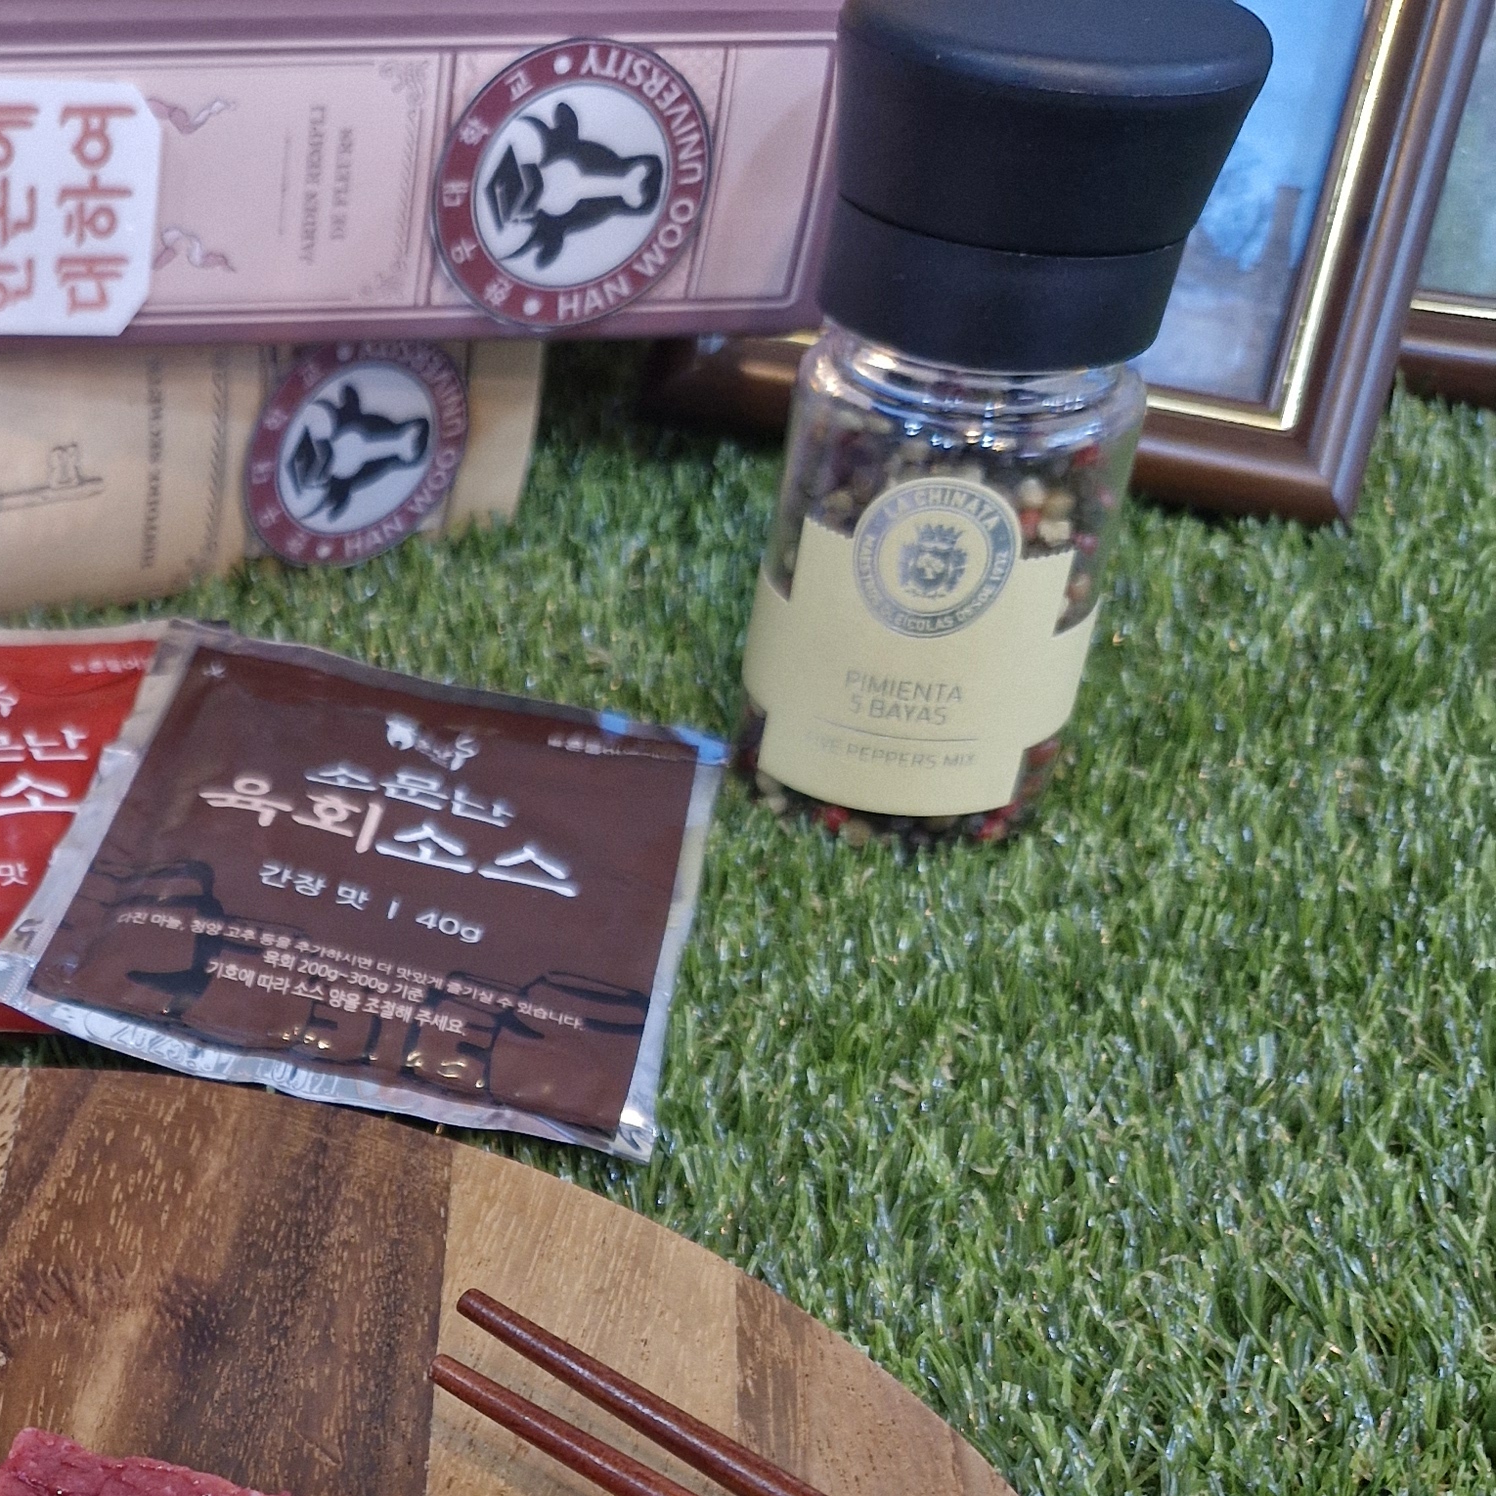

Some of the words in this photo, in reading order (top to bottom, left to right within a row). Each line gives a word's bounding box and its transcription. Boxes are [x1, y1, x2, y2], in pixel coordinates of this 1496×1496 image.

[580, 48, 703, 185] UNIVERSITY
[58, 104, 136, 316] 대하여
[442, 70, 533, 306] 한우대학교
[558, 275, 631, 320] HAN
[633, 199, 694, 277] WOO
[407, 450, 456, 514] WOO
[883, 496, 910, 519] LA
[914, 488, 1000, 531] CHINATA
[844, 669, 963, 702] PIMIENTA
[850, 694, 862, 714] 5
[868, 699, 947, 725] BAYAS
[846, 742, 937, 769] PEPPERS
[305, 766, 515, 827] 소문난
[198, 773, 580, 898] 육회소스
[258, 862, 328, 897] 간장
[335, 884, 371, 912] 맛
[414, 910, 485, 945] 40g
[205, 959, 255, 988] 기호에
[256, 972, 291, 995] 따라
[290, 981, 324, 1001] 소스
[329, 988, 361, 1013] 양을
[362, 996, 413, 1024] 조절해
[414, 1007, 466, 1036] 주세요.
[223, 926, 256, 941] 고추
[259, 932, 291, 949] 등을
[294, 939, 373, 970] 추가하시면
[376, 961, 392, 976] 더
[396, 966, 443, 990] 맛있게
[446, 981, 494, 1006] 즐기실
[495, 995, 513, 1009] 수
[517, 1000, 584, 1031] 있습니다.
[262, 950, 296, 971] 육회
[297, 959, 390, 994] 200g~300g
[391, 981, 425, 1003] 기준
